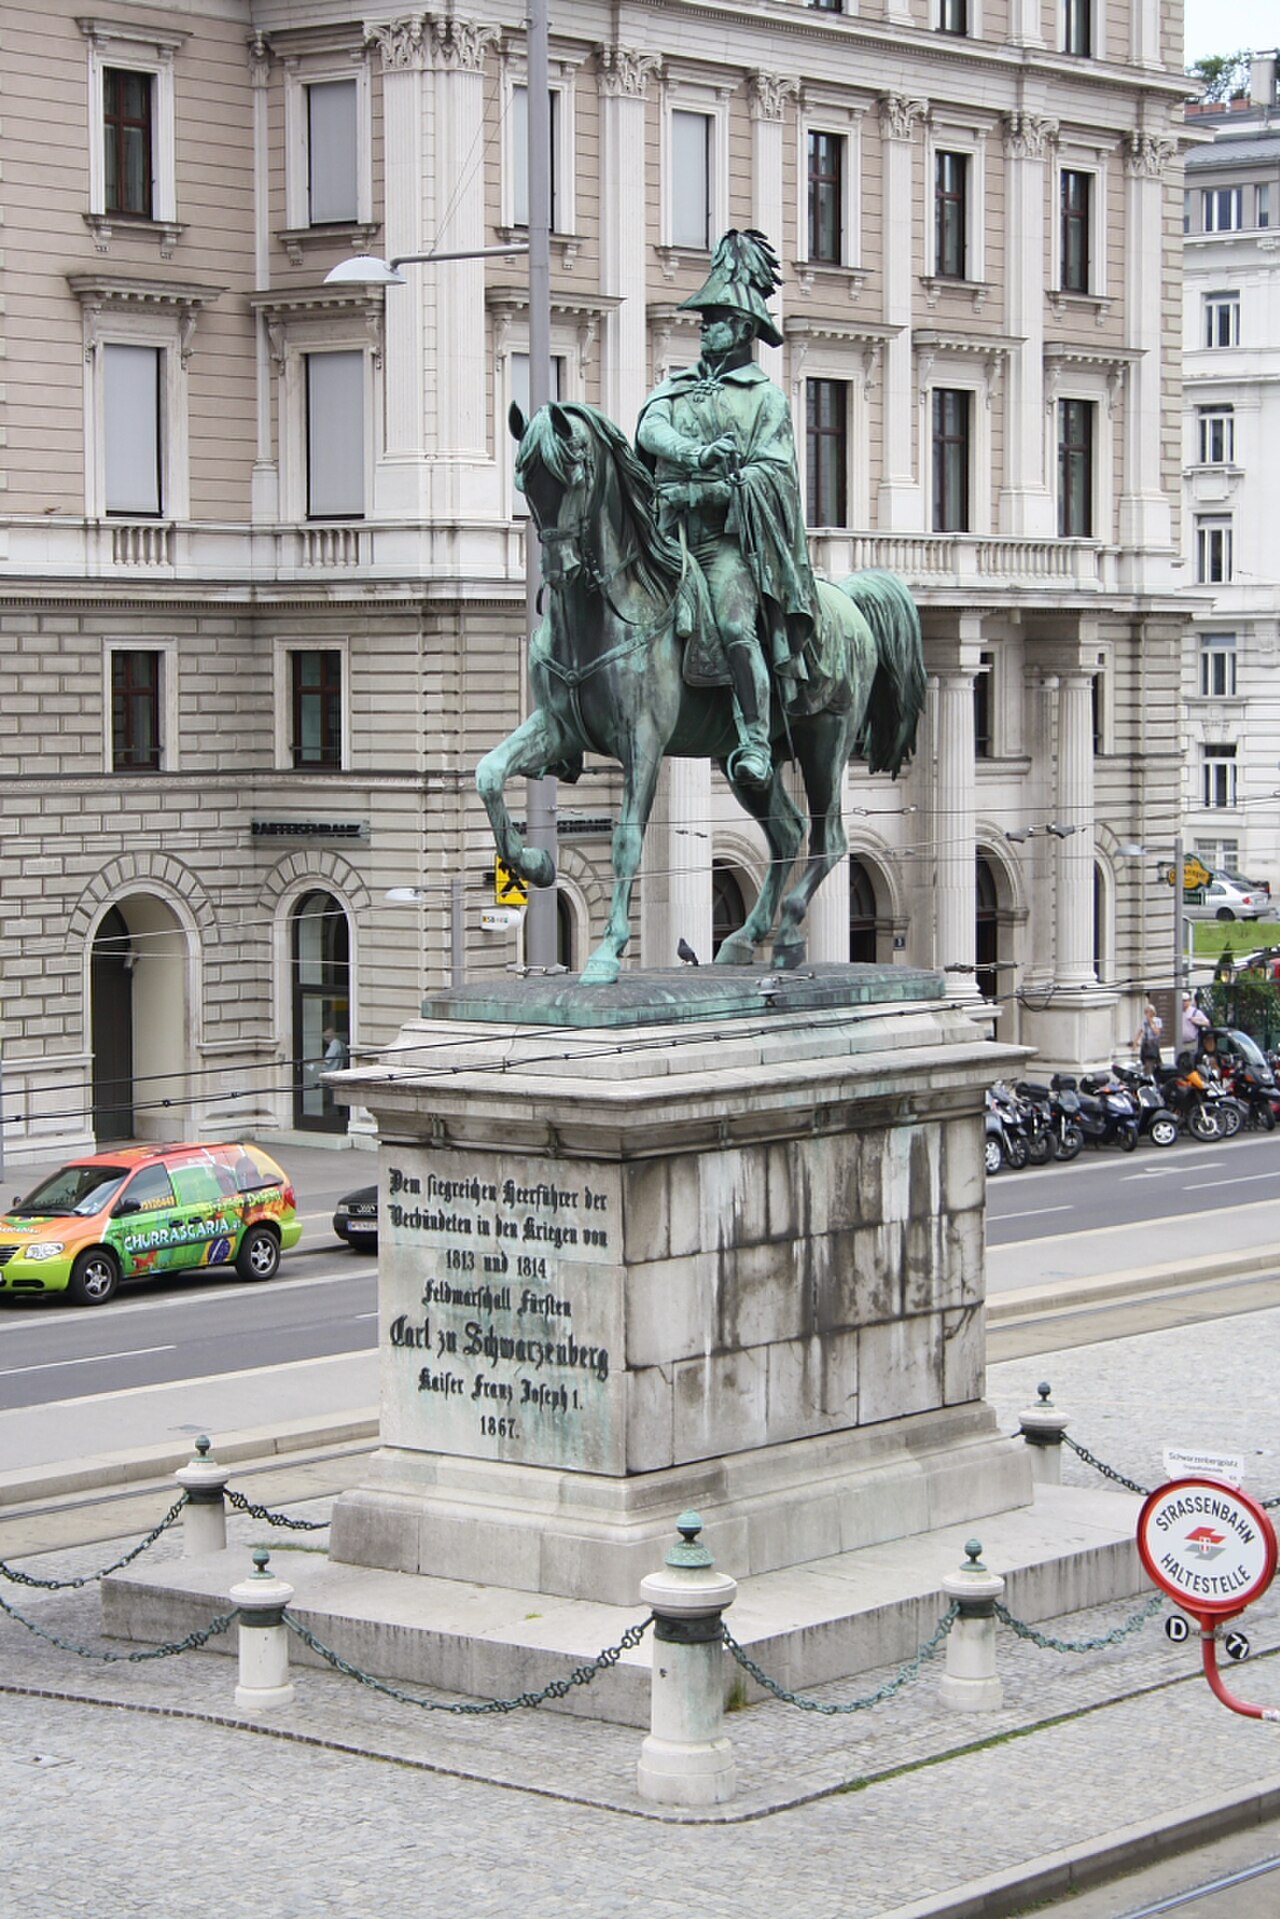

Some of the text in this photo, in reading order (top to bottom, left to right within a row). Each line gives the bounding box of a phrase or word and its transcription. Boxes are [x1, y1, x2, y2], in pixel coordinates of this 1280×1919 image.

[388, 1168, 421, 1195] Dem
[502, 1179, 579, 1213] Heerführer
[585, 1186, 608, 1210] der
[387, 1204, 608, 1248] Verbündeten in den Kriegen von
[446, 1249, 547, 1278] 1813 und 1814
[517, 1289, 572, 1318] Fürsten
[389, 1315, 609, 1383] Carl zu Schwarzenberg
[471, 1374, 513, 1406] Franz
[480, 1415, 521, 1439] 1867.
[1155, 1496, 1255, 1545] STRASSENBAHN
[1160, 1552, 1251, 1594] HALTESTELLE
[1169, 1617, 1187, 1640] D
[1227, 1633, 1249, 1659] 71
